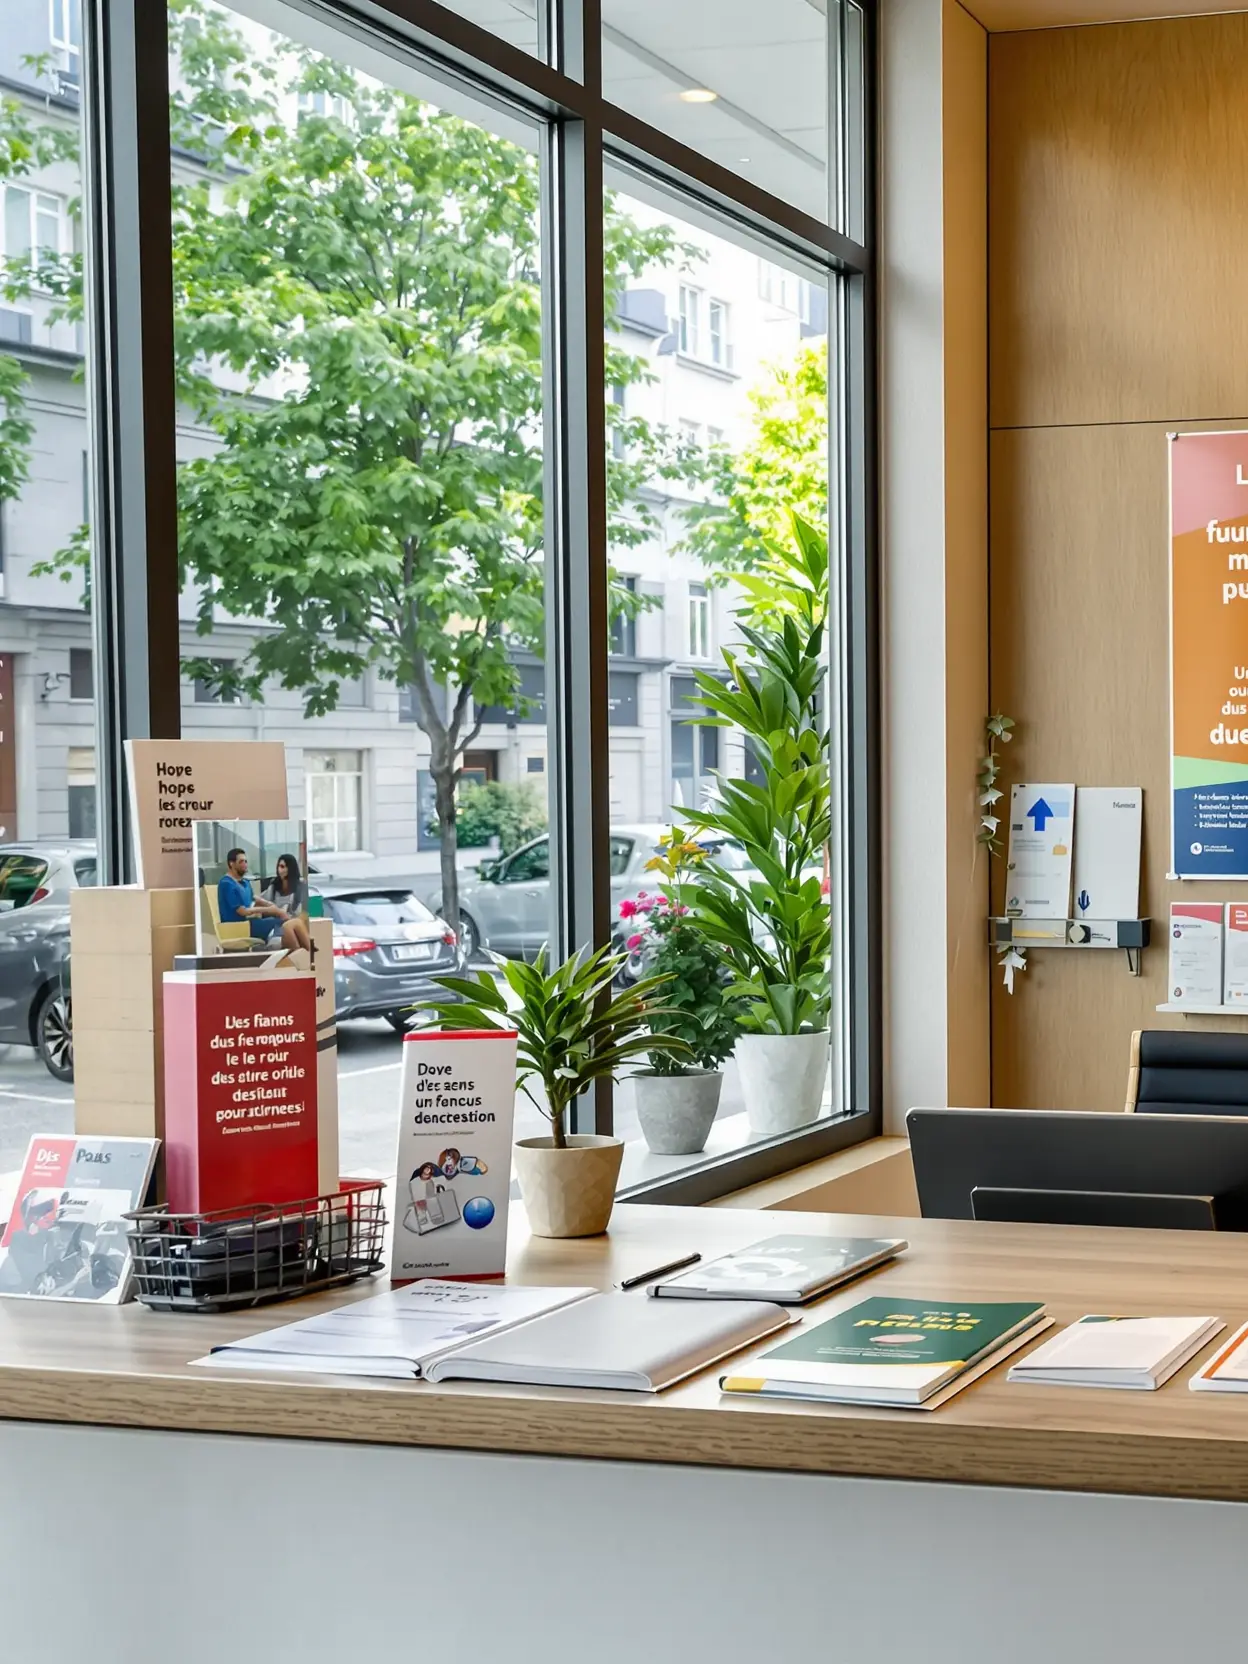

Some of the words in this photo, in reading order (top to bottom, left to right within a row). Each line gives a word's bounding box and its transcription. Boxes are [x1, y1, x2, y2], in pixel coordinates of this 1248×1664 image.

[1221, 701, 1247, 716] dus
[210, 1035, 235, 1049] dus
[417, 1062, 452, 1076] Dove
